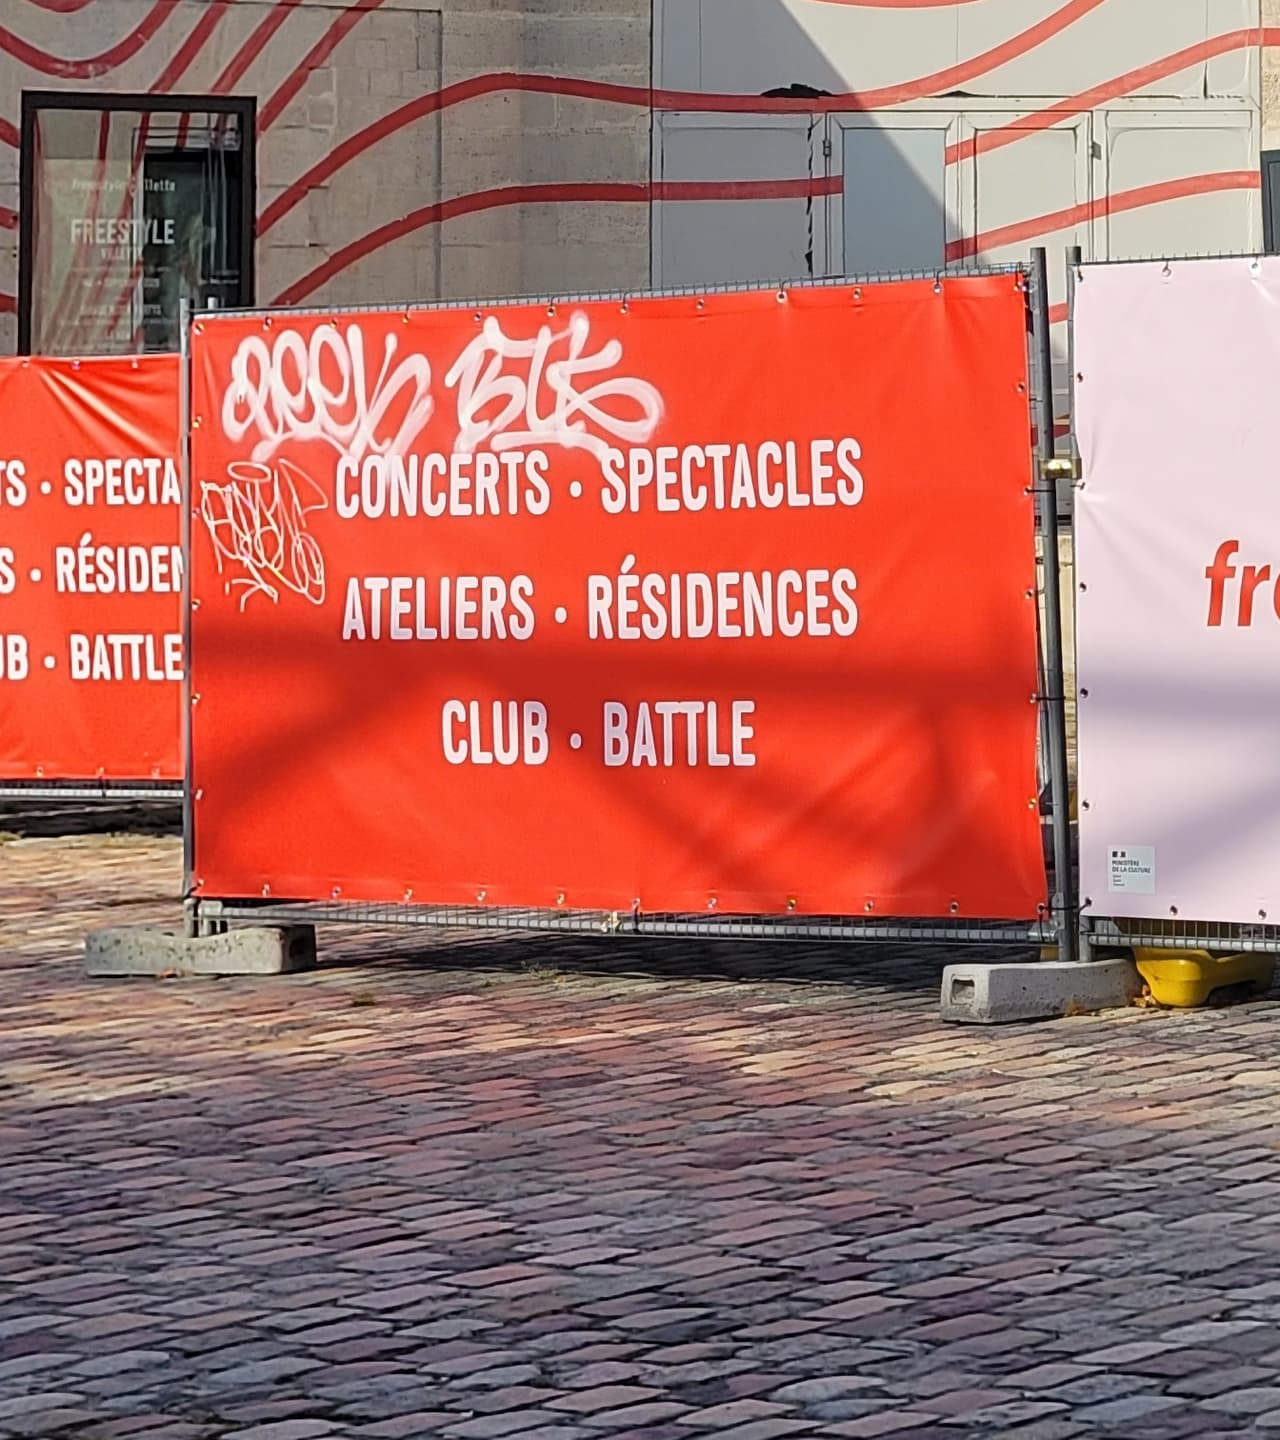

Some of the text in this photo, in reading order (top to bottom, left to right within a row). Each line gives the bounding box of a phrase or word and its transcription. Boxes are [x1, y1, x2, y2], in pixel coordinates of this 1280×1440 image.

[71, 219, 176, 245] FREESTYLE
[64, 457, 181, 506] SPECTA
[334, 438, 864, 519] CONCERTS SPECTACLES
[342, 554, 858, 640] ATELIERS RÉSIDENCES
[70, 633, 185, 681] BATTLE
[442, 699, 756, 767] CLUB BATTLE
[1127, 866, 1151, 874] CULTURE
